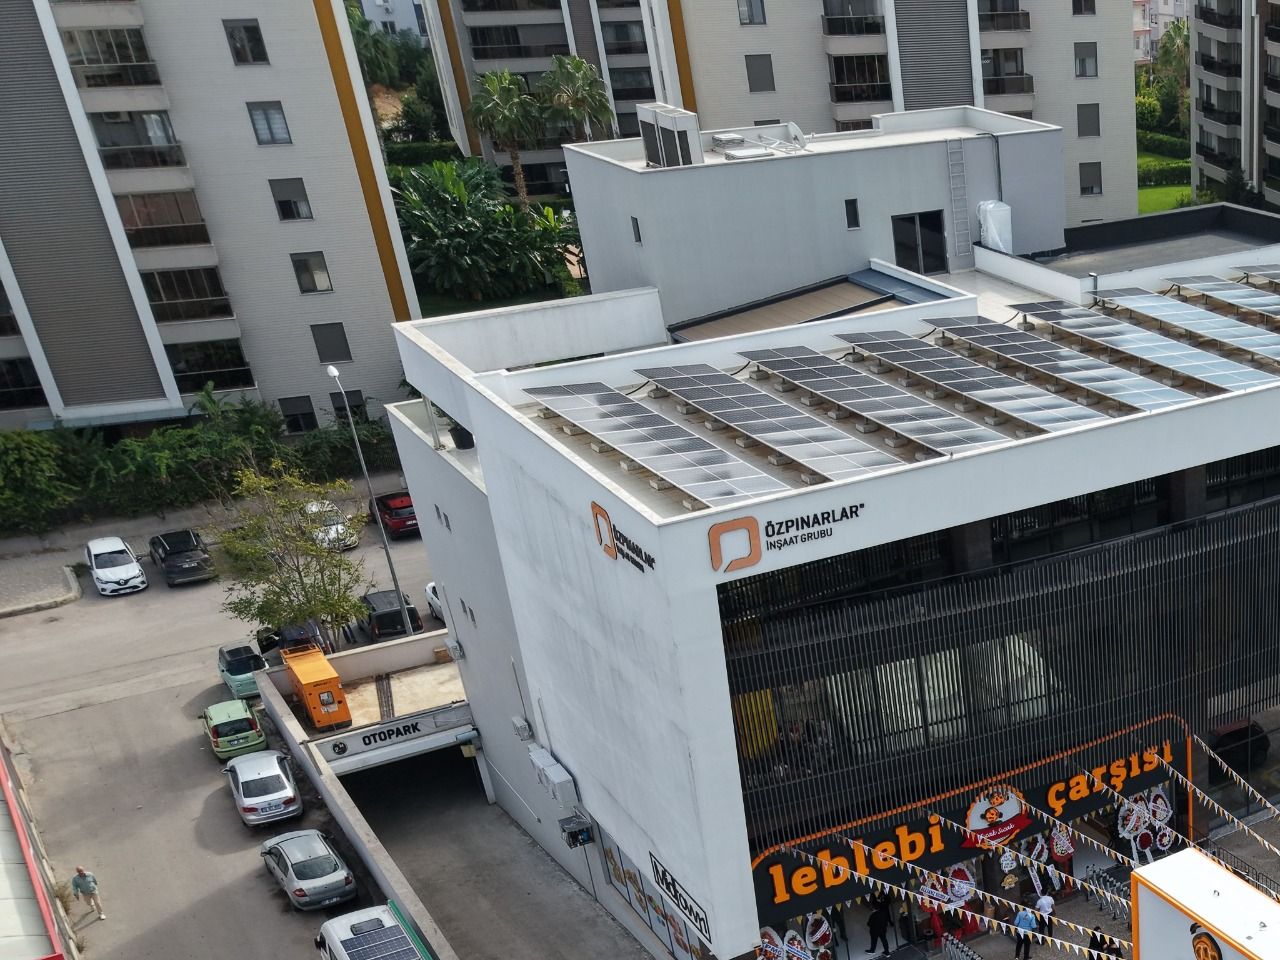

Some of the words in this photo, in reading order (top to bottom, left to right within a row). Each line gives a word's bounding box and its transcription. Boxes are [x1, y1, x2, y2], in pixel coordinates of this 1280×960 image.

[764, 504, 860, 538] ÖZPINARLAR
[800, 527, 833, 543] GRUBU
[361, 721, 421, 746] OTOPARK
[768, 813, 945, 904] leblebi
[1047, 739, 1173, 817] çarşısı
[652, 860, 708, 934] Midtown
